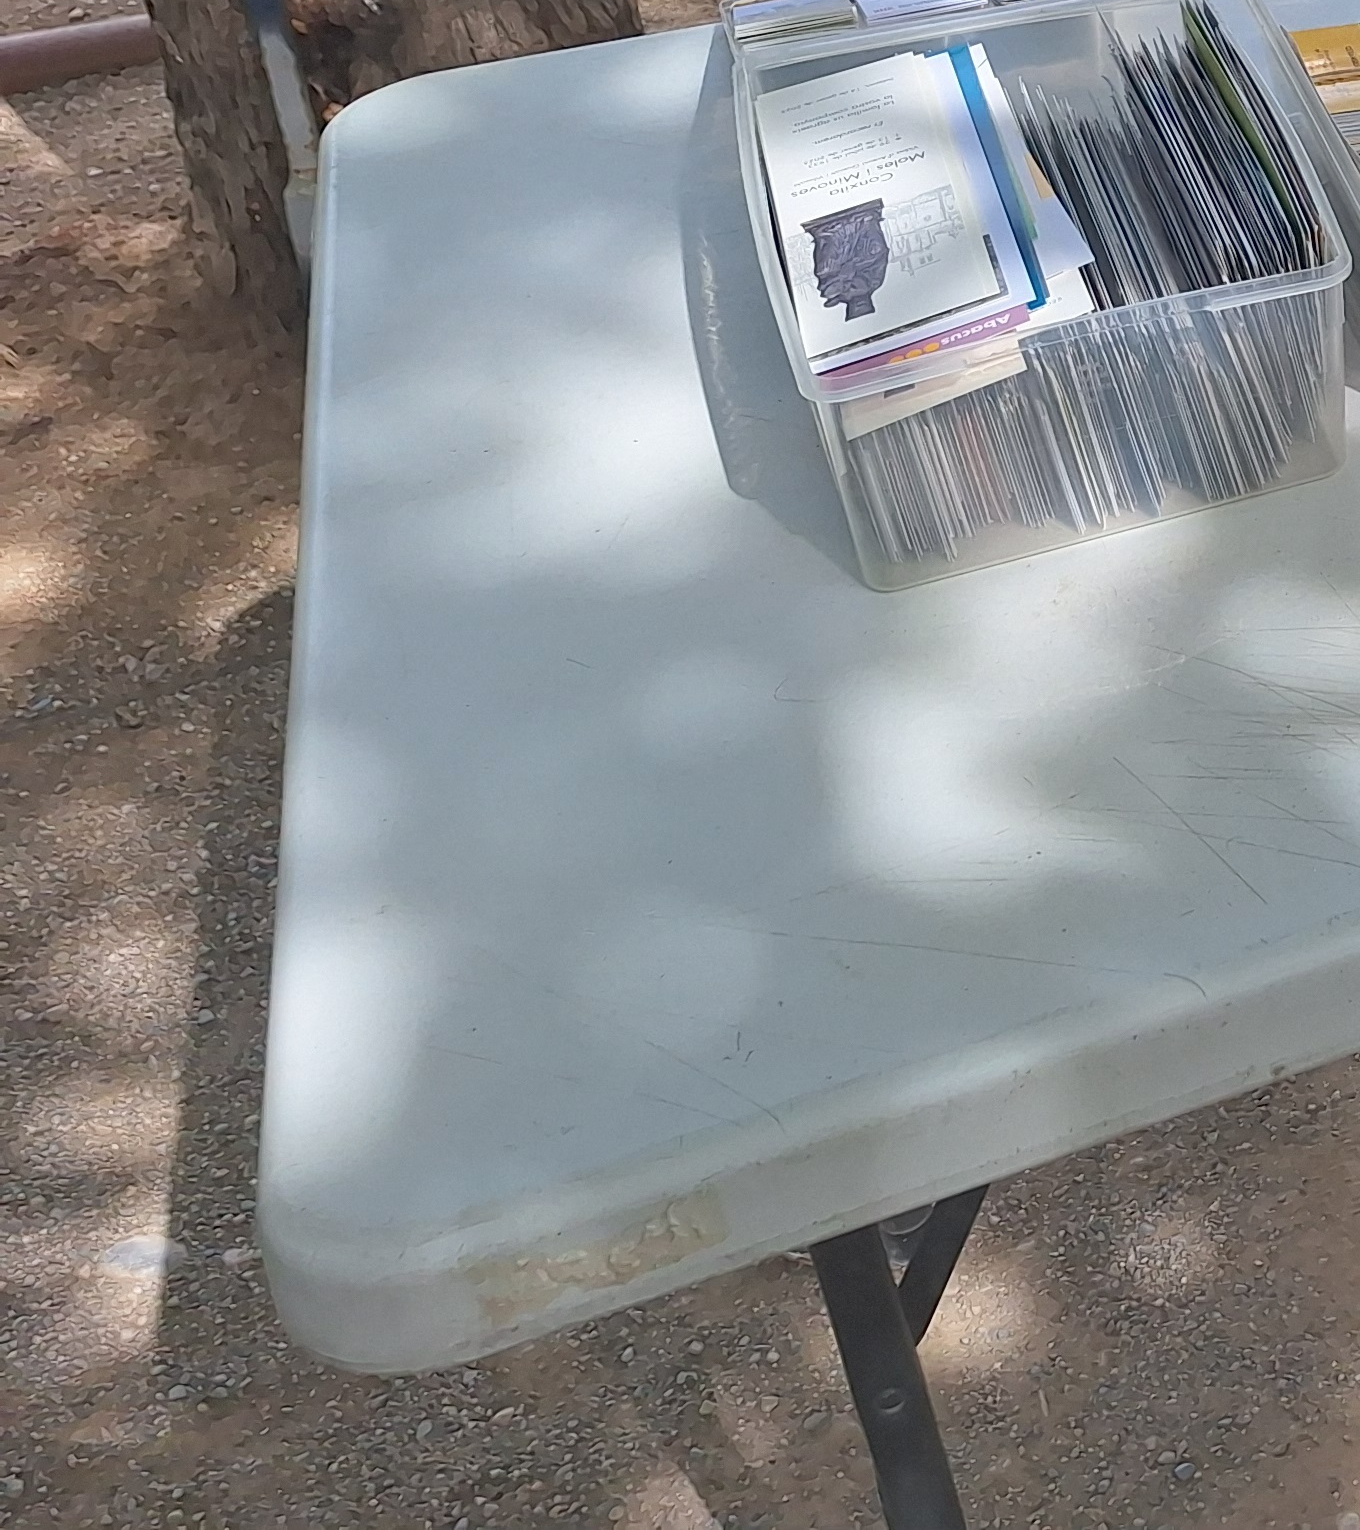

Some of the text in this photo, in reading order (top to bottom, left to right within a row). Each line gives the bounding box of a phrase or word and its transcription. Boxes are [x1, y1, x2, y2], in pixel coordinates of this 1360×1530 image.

[875, 150, 926, 172] Moles
[789, 171, 860, 198] Minoves
[941, 311, 1013, 344] Abacus
